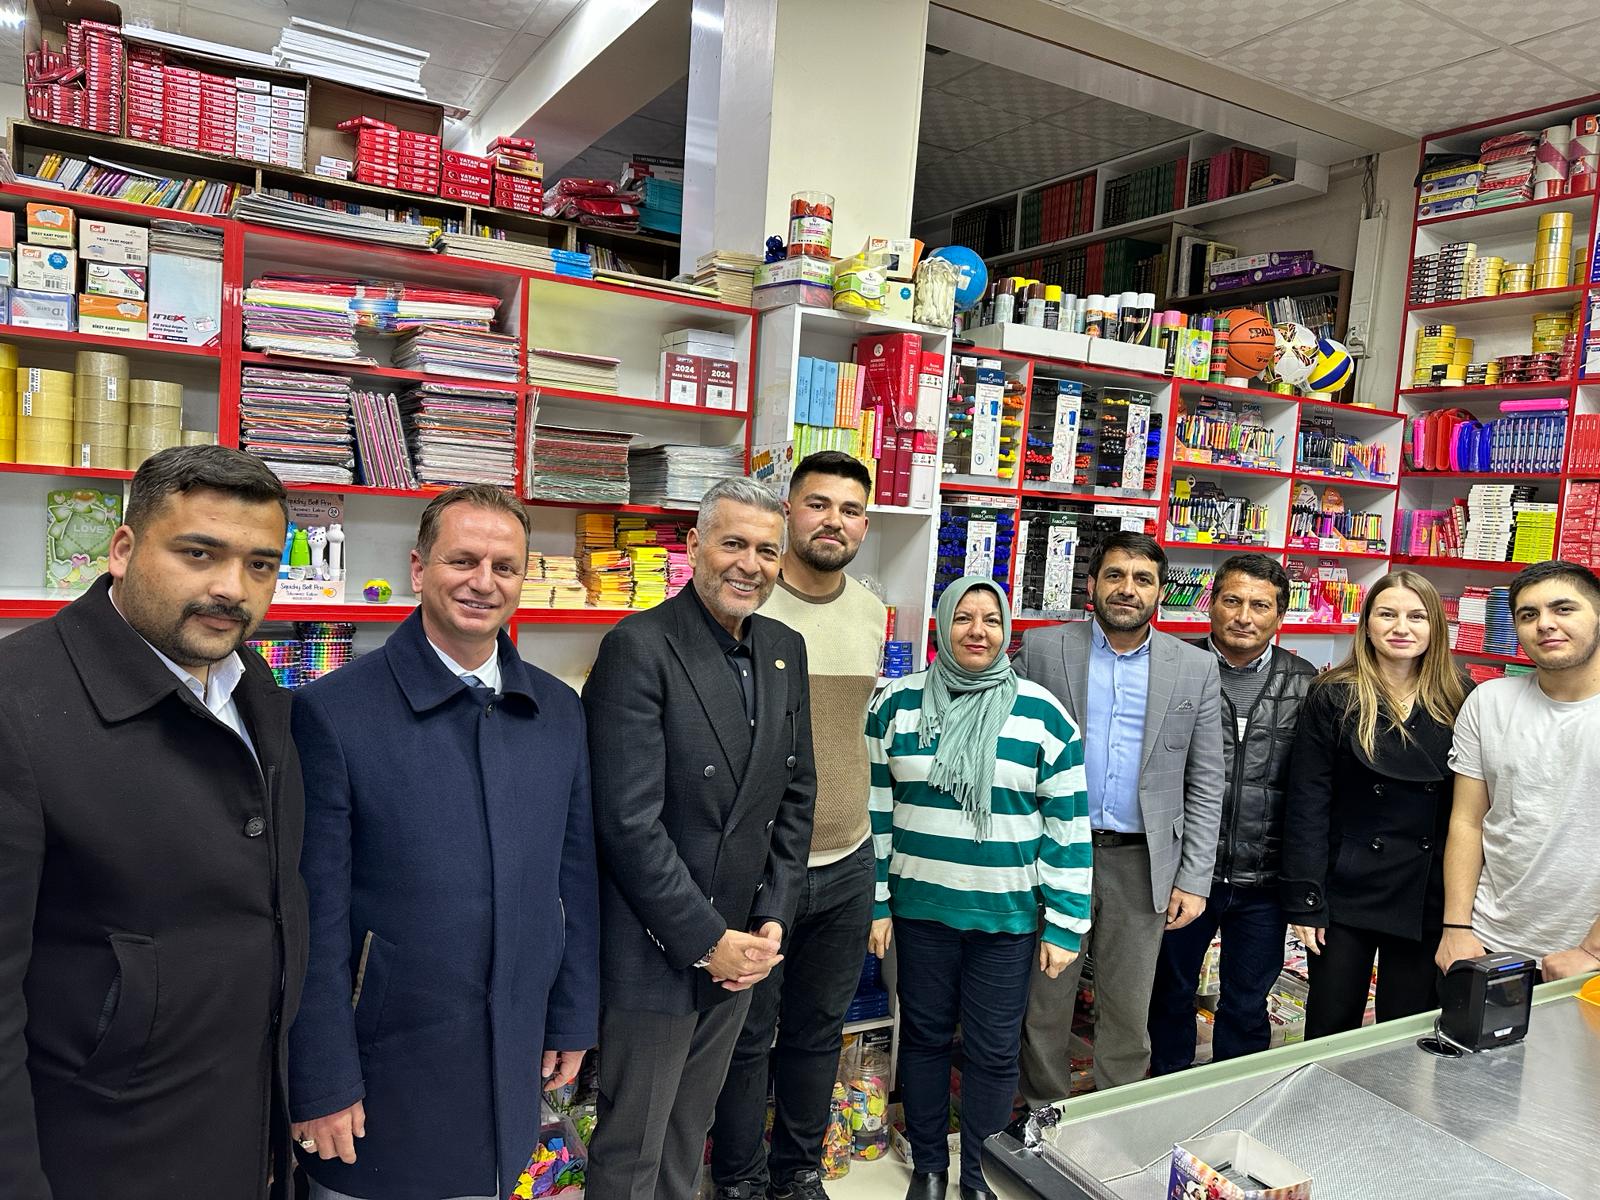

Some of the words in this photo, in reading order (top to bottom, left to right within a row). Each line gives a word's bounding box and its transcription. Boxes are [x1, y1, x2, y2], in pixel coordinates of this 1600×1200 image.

[460, 173, 481, 182] VATAN
[461, 189, 481, 197] VATAN
[675, 364, 695, 374] 2024
[711, 369, 731, 379] 2024
[73, 524, 105, 534] LOVE
